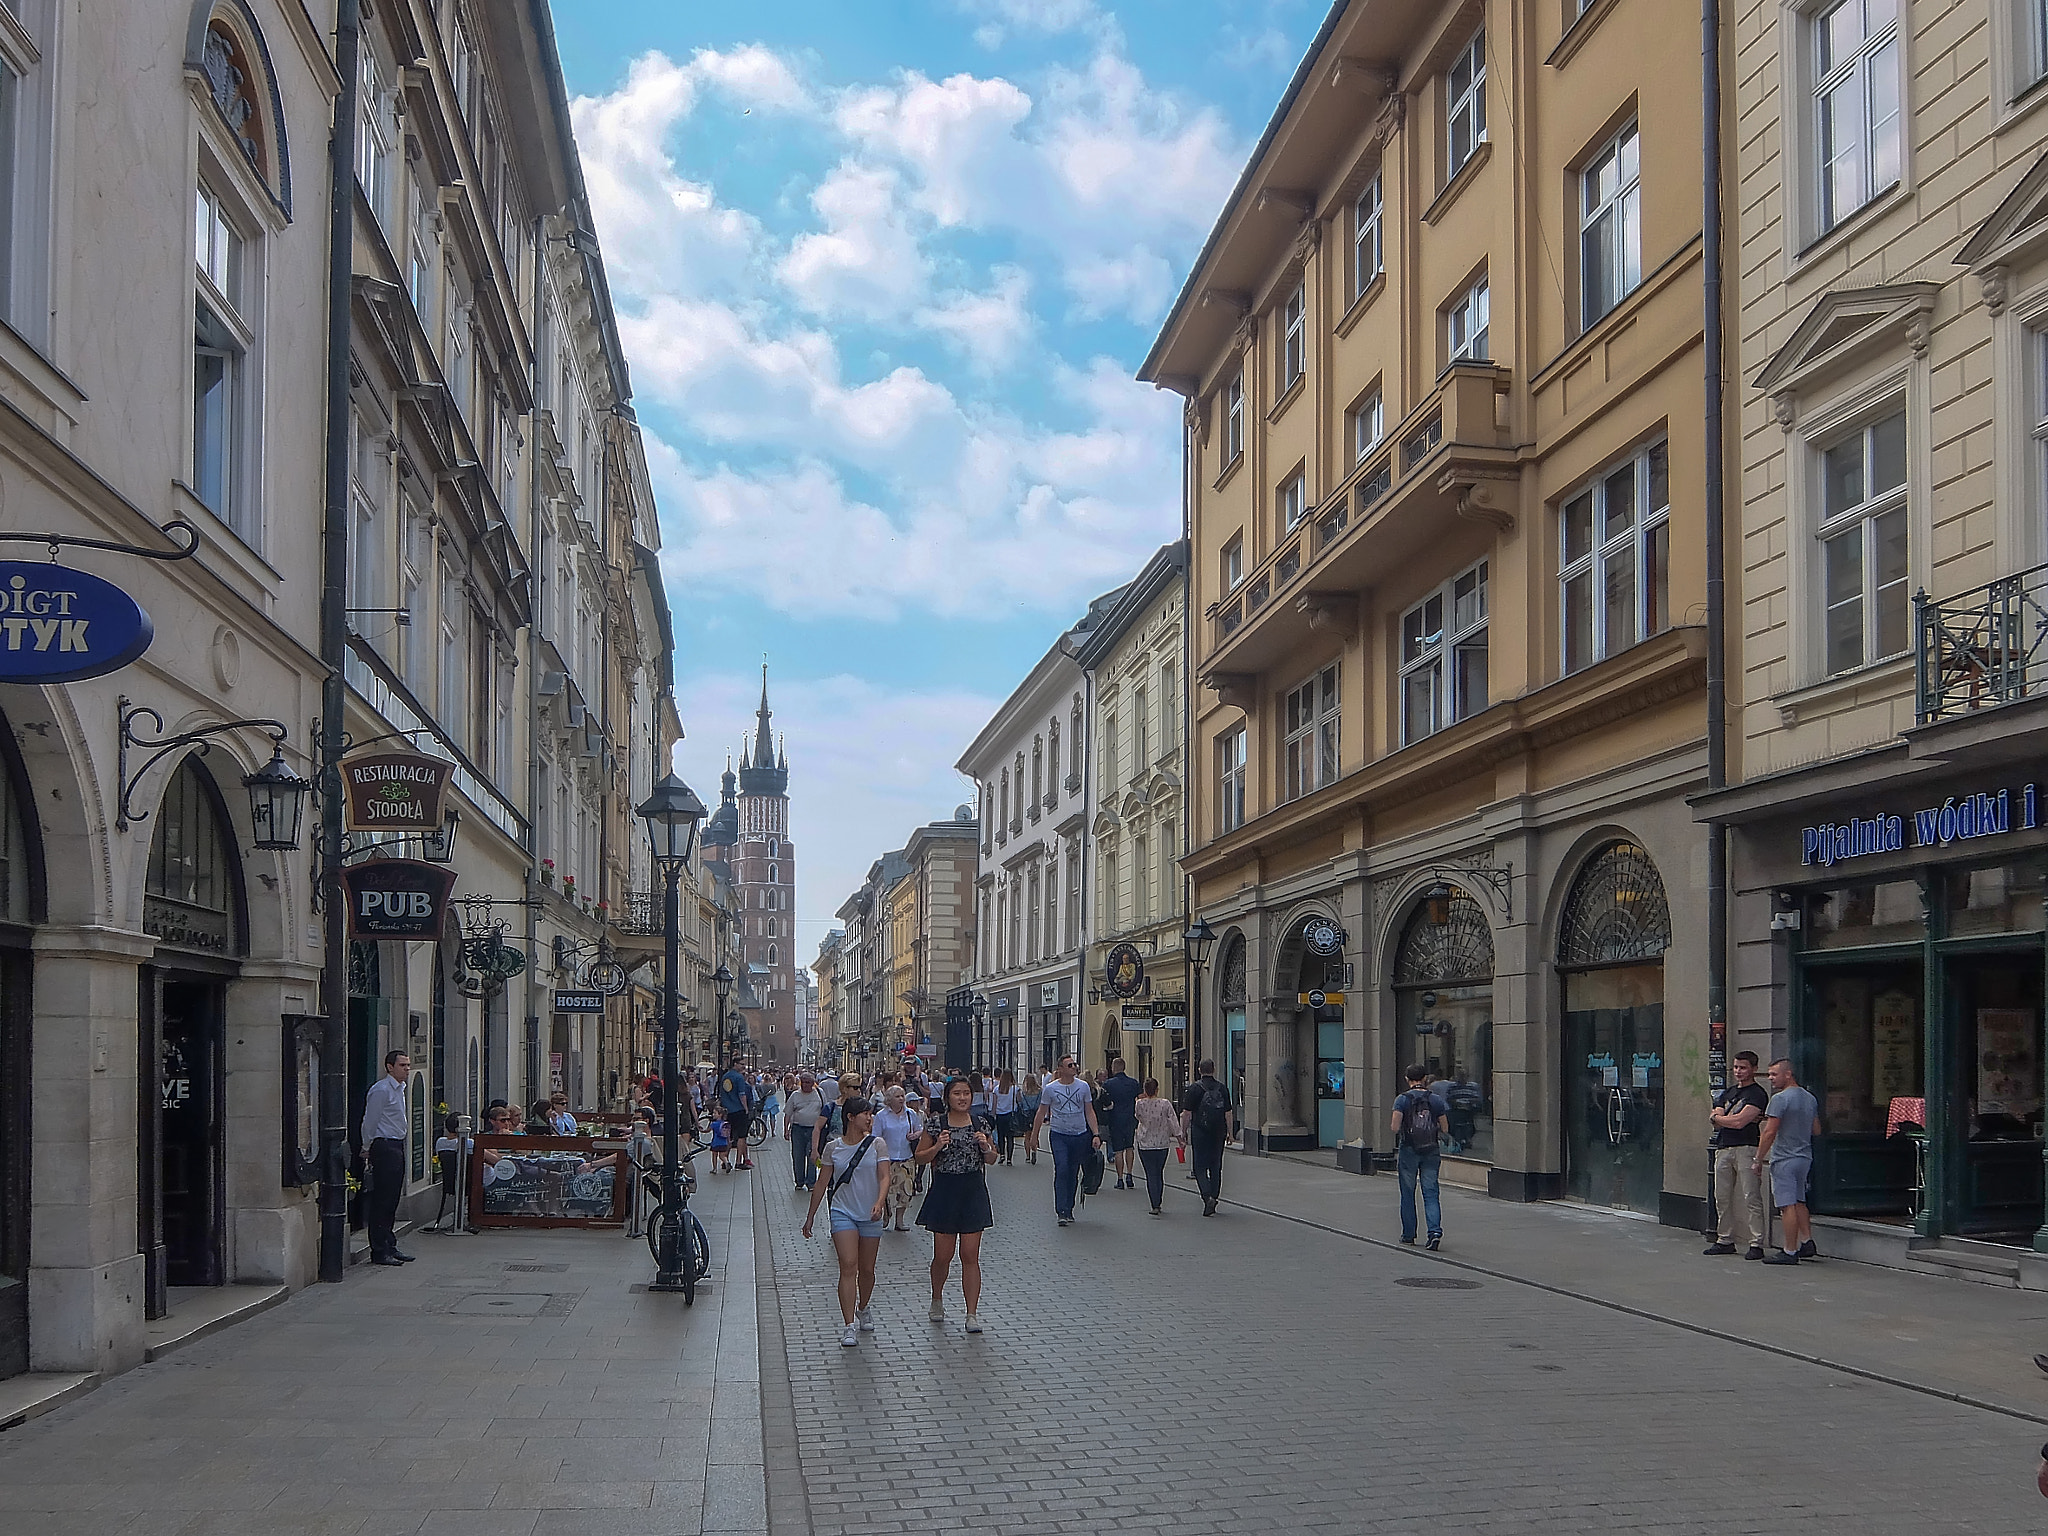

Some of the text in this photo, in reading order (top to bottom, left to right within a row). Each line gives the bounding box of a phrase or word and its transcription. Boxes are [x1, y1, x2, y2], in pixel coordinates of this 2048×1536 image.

[353, 764, 436, 785] RESTAURACJA
[253, 803, 269, 823] 47
[366, 798, 424, 820] STODOŁA
[1800, 783, 2036, 867] Pijalnia wódki i
[360, 890, 433, 918] PUB
[556, 996, 602, 1008] HOSTEL
